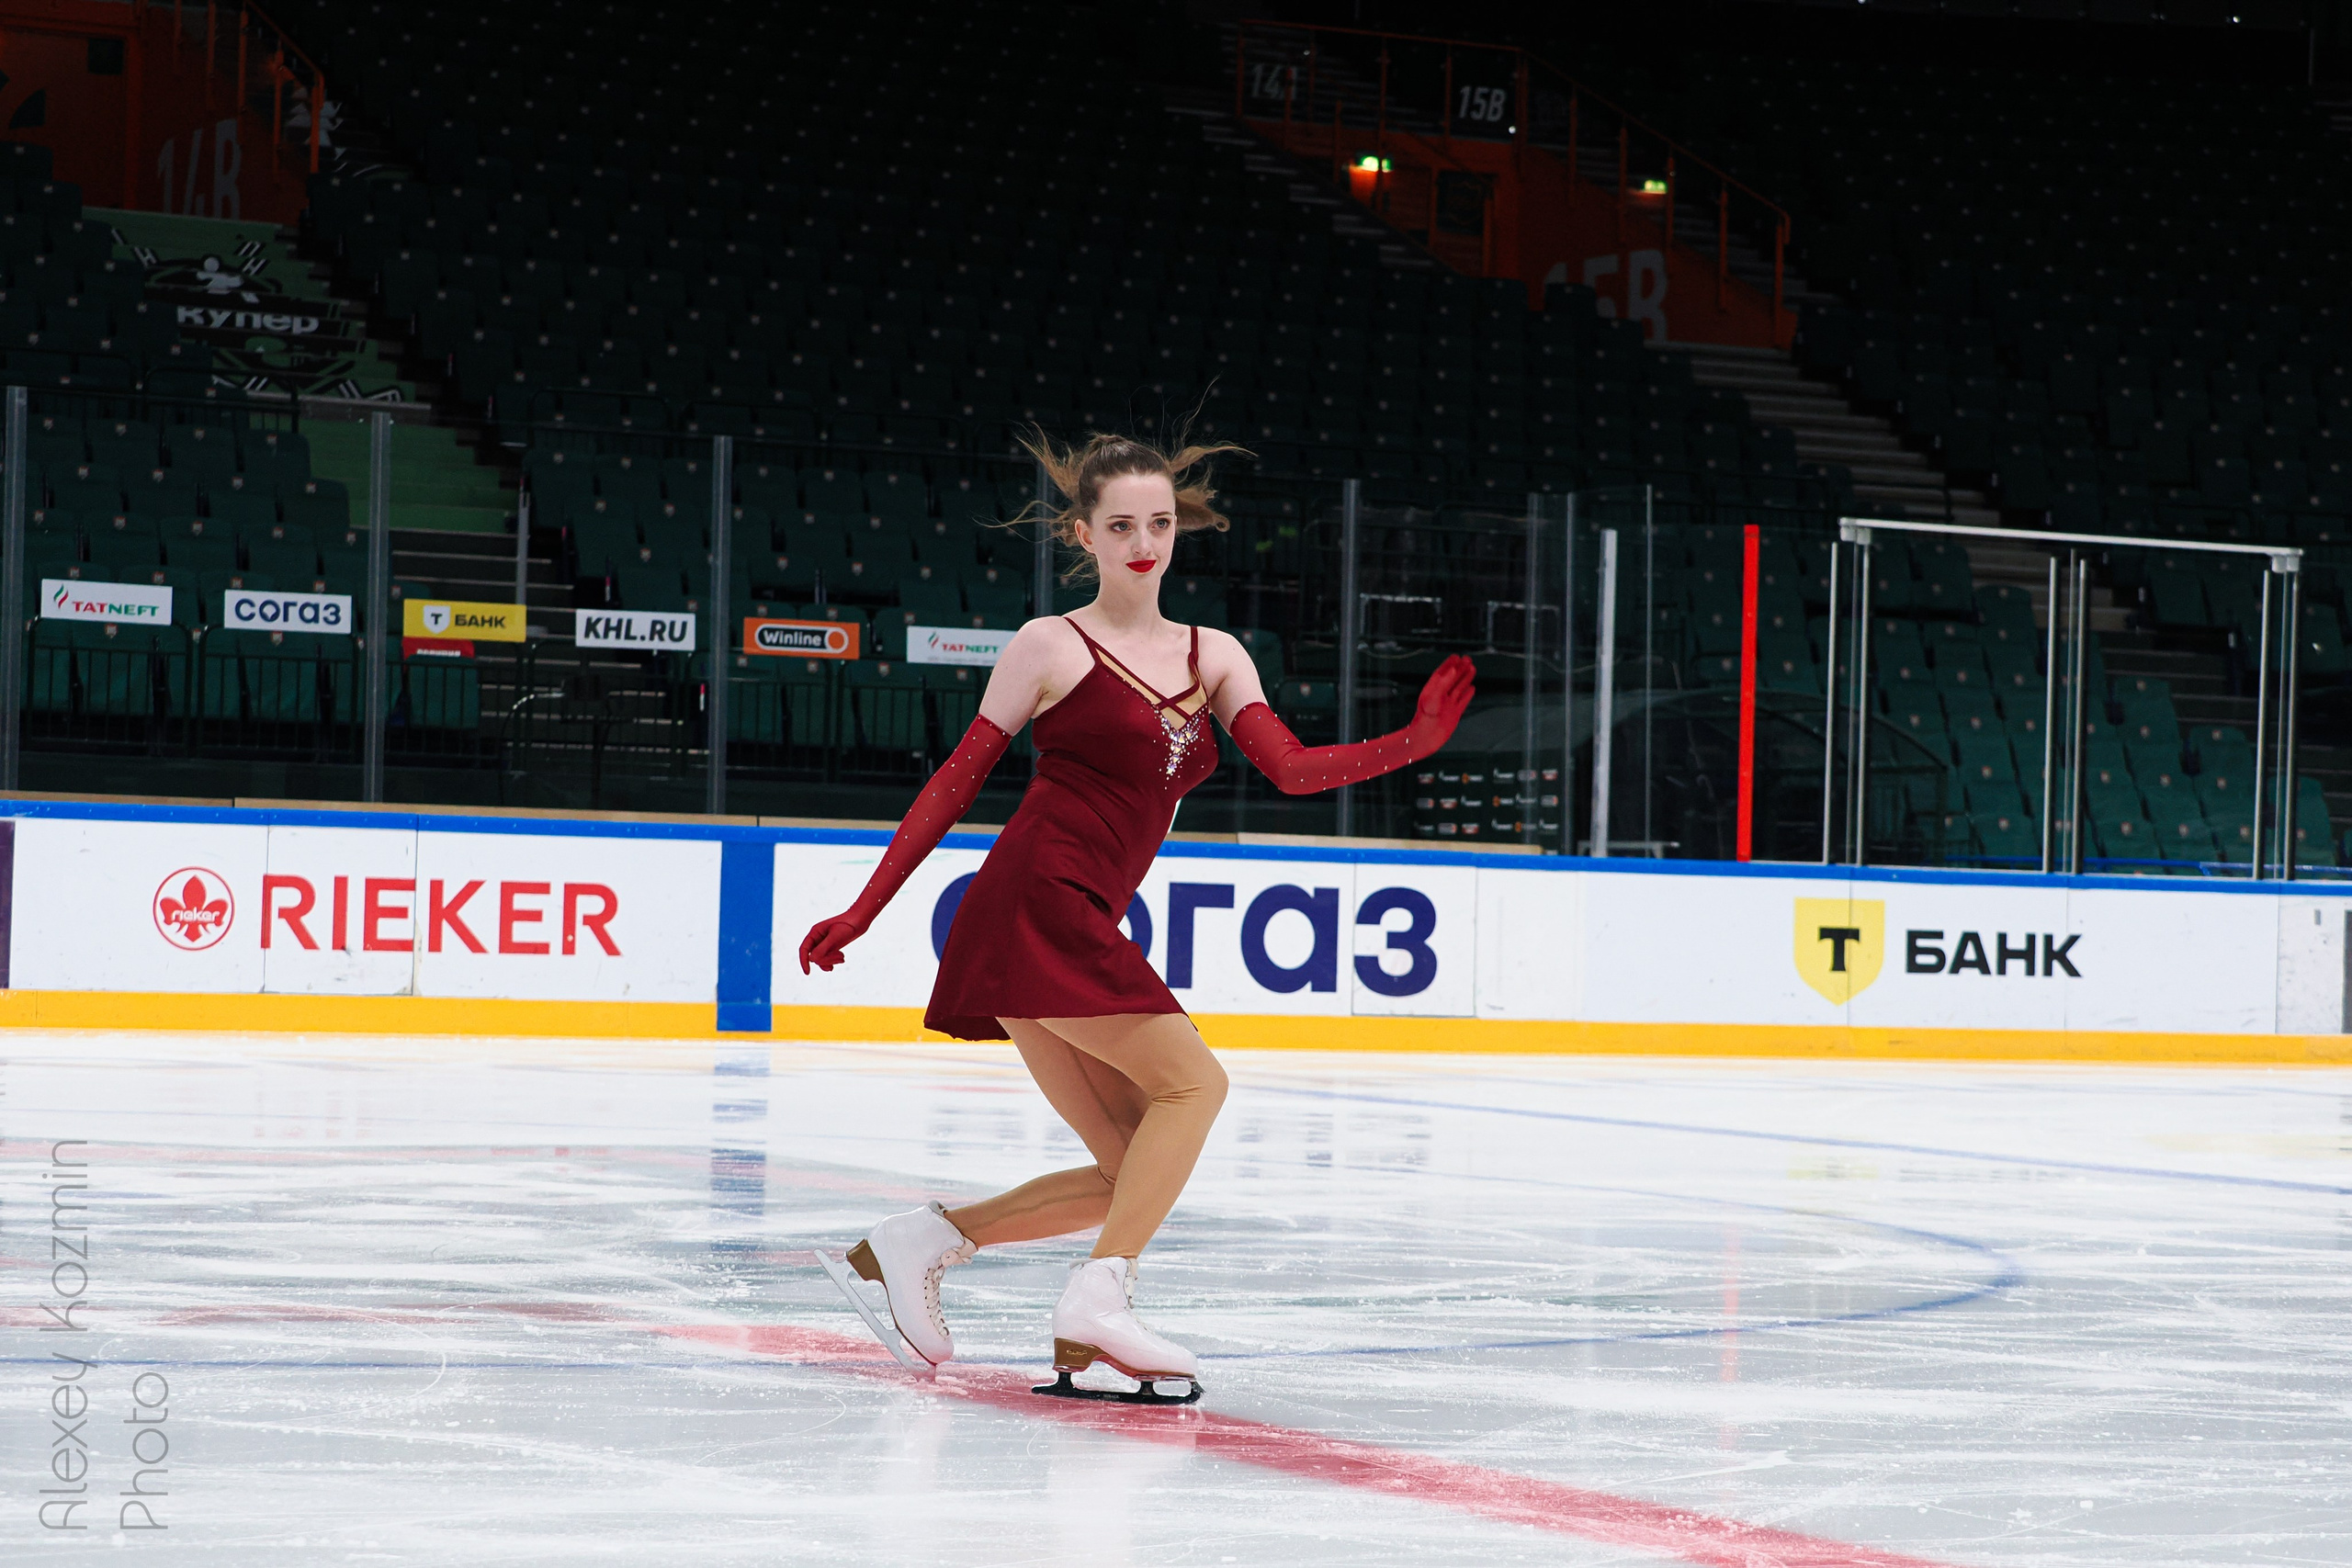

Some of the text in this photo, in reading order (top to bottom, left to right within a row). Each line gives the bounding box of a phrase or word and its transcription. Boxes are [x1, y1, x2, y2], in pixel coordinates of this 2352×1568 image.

[1458, 85, 1507, 122] 15B
[73, 601, 159, 616] TATNEFT
[455, 614, 506, 628] БАНК
[584, 616, 688, 643] KHL.RU
[763, 628, 822, 647] Winline
[942, 644, 999, 653] TATNEFT
[172, 907, 220, 921] rieker
[260, 874, 622, 957] RIEKER
[932, 871, 1437, 996] газ
[1905, 930, 2083, 977] БАНК
